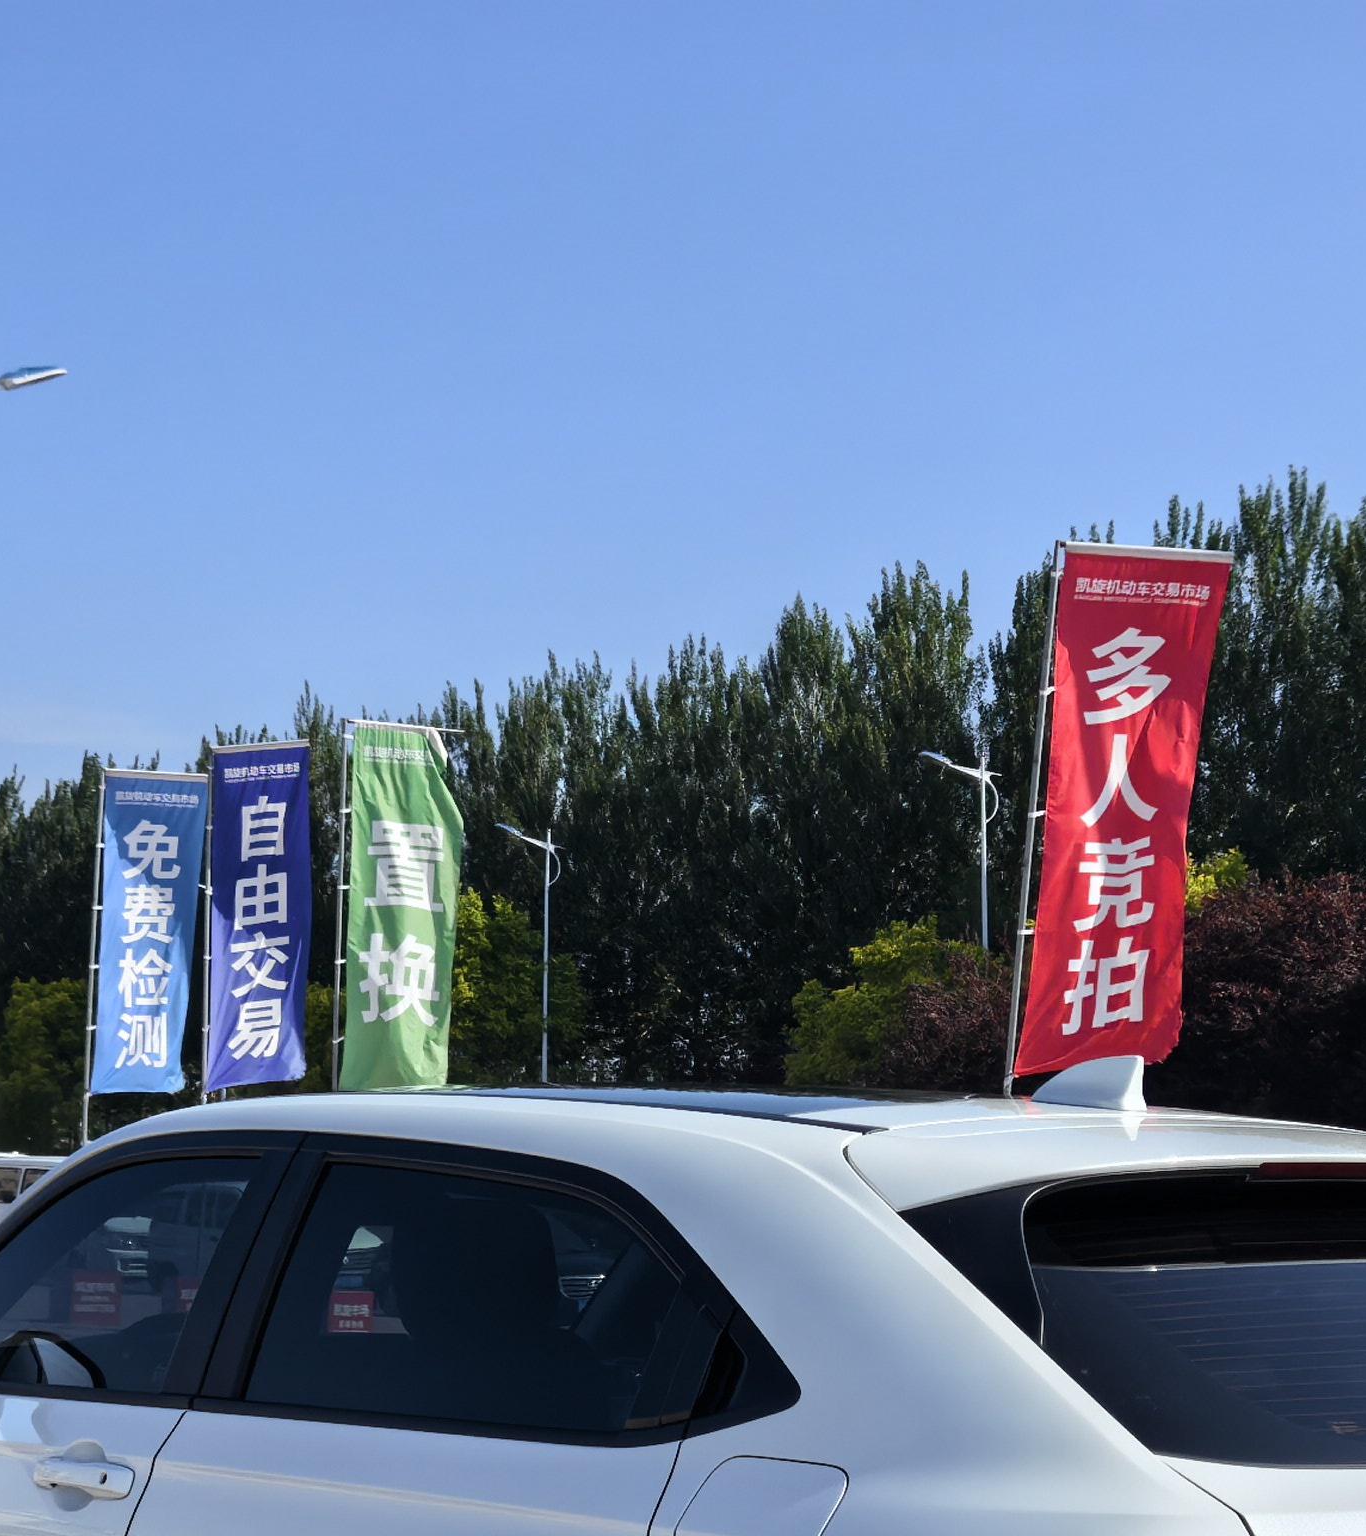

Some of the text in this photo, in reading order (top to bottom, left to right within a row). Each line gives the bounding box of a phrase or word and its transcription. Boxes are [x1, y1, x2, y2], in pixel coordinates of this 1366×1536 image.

[1074, 577, 1211, 601] 凯旋机动车交易市场
[114, 818, 181, 1069] 免费检测
[229, 795, 290, 1060] 自由交易
[358, 820, 445, 1028] 置换
[1061, 626, 1171, 1036] 多人竞拍
